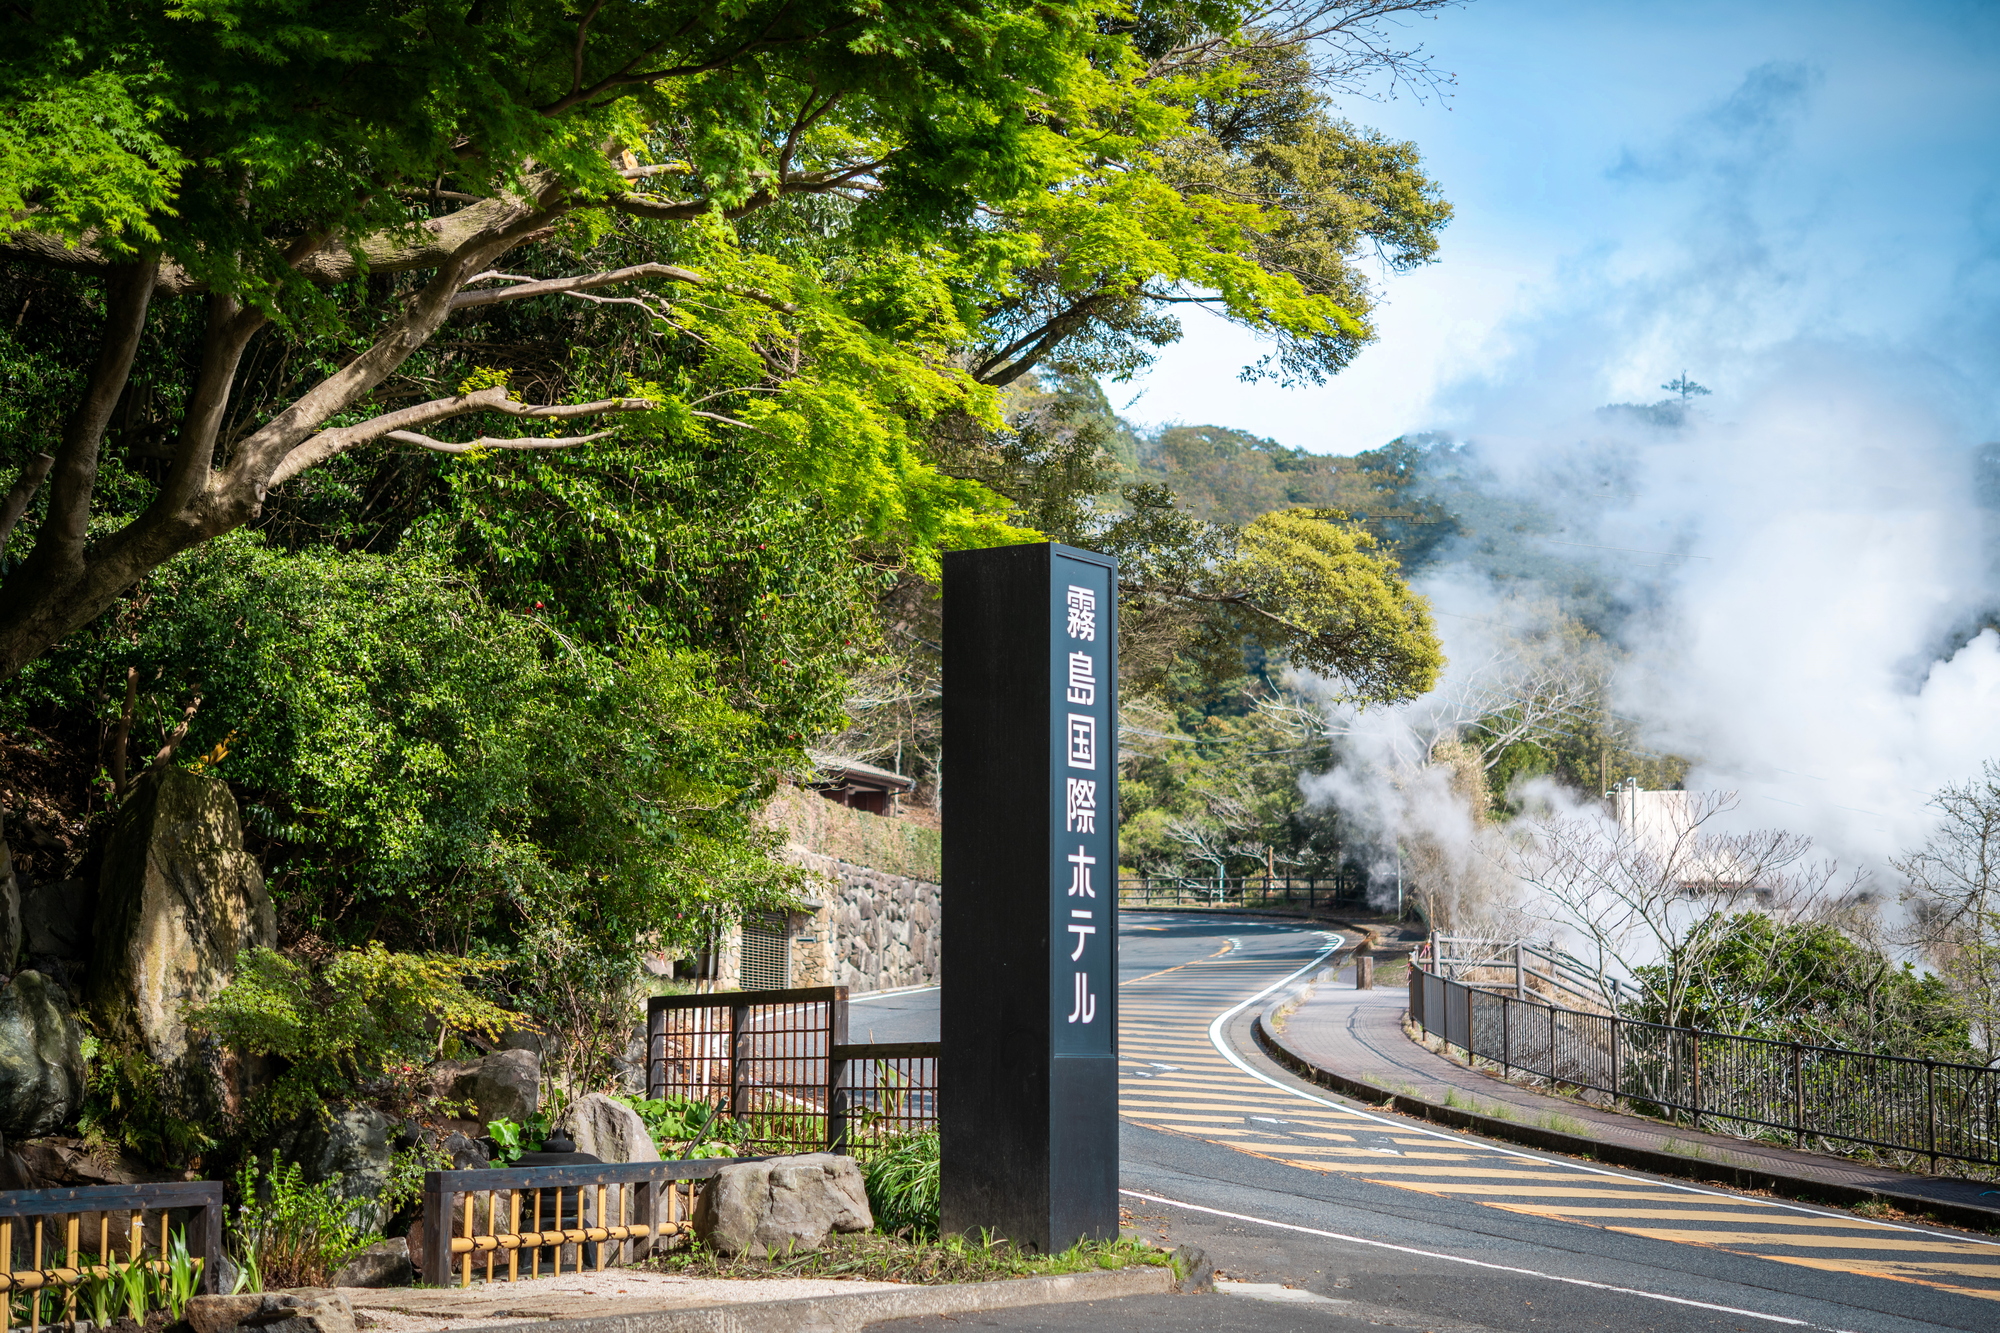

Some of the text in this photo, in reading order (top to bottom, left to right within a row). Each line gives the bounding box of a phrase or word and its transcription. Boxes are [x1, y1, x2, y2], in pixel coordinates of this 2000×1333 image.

[1067, 585, 1096, 1023] 霧島国際ホテル
